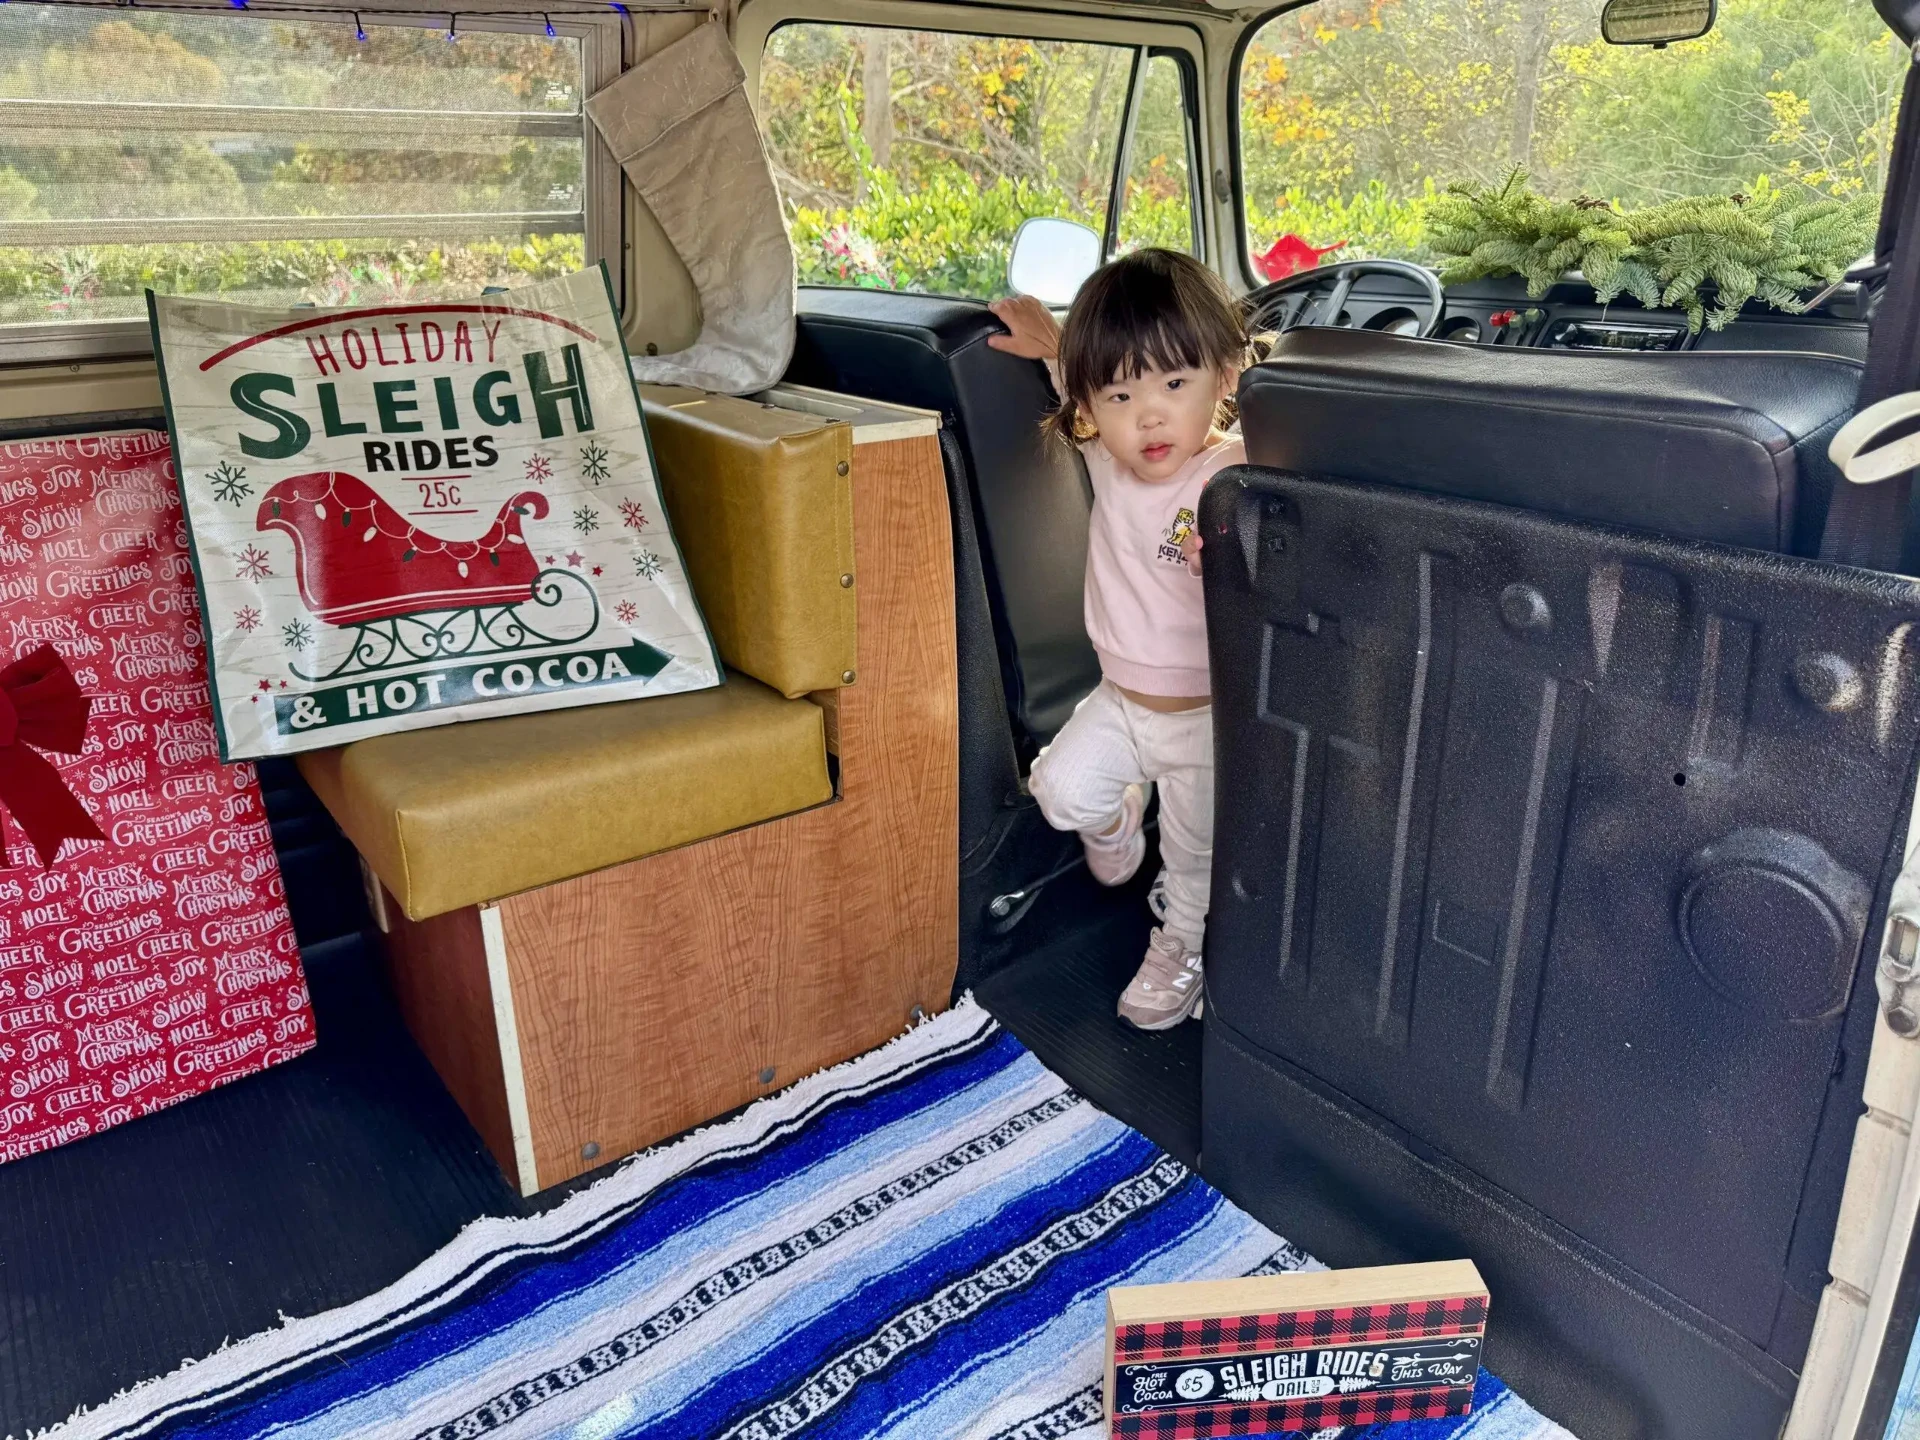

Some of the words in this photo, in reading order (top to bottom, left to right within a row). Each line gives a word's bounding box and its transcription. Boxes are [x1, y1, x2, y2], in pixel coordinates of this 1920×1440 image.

[306, 320, 502, 377] HOLIDAY
[230, 344, 595, 460] SLEIGH
[77, 432, 170, 460] GREETING
[363, 436, 499, 473] RIDES
[42, 465, 82, 494] JOY
[89, 466, 162, 497] MERRY
[95, 487, 180, 517] CHRISTMAS
[22, 507, 82, 539] SNOW
[42, 538, 90, 562] NOEL
[100, 530, 164, 552] CHEER
[1158, 544, 1188, 562] KEN
[46, 562, 152, 598] GREETINGS
[83, 565, 119, 575] SEASON'S
[0, 576, 38, 602] NOW
[9, 615, 84, 648] MERRY
[88, 605, 154, 629] CHEER
[109, 632, 181, 664] MERRY
[115, 652, 199, 682] CHRISTMAS
[89, 695, 138, 716] HEER
[141, 686, 209, 713] GREETI
[289, 696, 327, 730] &
[347, 675, 447, 718] HOT
[472, 652, 631, 698] COCOA
[108, 720, 146, 750] JOY
[89, 760, 147, 793] SNOW
[161, 775, 224, 800] CHEER
[108, 788, 154, 814] NOEL
[220, 793, 253, 822] JOY
[112, 806, 213, 846] GREETINGS
[146, 811, 181, 823] SEASON'S
[152, 848, 214, 873] CHEER
[241, 852, 279, 882] SNO
[28, 872, 68, 901] JOY
[78, 866, 148, 898] MERRY
[173, 873, 239, 904] MERRY
[83, 880, 167, 915] CHRISTMAS
[177, 886, 255, 921] CHRISTMAS
[21, 902, 70, 930] NOEL
[94, 916, 130, 930] SEASON'S
[201, 904, 290, 947] GREETINGS
[233, 911, 266, 923] SEASON'S
[59, 909, 162, 954] GREETINGS
[138, 933, 200, 960] CHEER
[0, 945, 53, 969] HEER
[93, 953, 140, 981] NOEL
[170, 956, 206, 986] JOY
[213, 948, 277, 982] MERRY
[25, 963, 84, 999] SNOW
[100, 981, 135, 994] SEASON'S
[218, 960, 293, 997] CHRISTMAS
[64, 973, 167, 1019] GREETINGS
[153, 992, 207, 1028] SNOW
[0, 1004, 63, 1033] CHEER
[220, 1000, 279, 1028] CHEER
[273, 1013, 307, 1042] JOY
[21, 1030, 61, 1061] JOY
[74, 1019, 145, 1054] MERRY
[169, 1019, 213, 1047] NOEL
[206, 1038, 239, 1051] SEASON'S
[80, 1031, 163, 1070] CHRISTMAS
[174, 1028, 267, 1076] GREETINGS
[10, 1059, 70, 1098] SNOW
[111, 1059, 167, 1098] SNOW
[45, 1084, 110, 1114] CHEER
[0, 1101, 35, 1134] JOY
[95, 1104, 132, 1132] JOY
[20, 1125, 57, 1141] SEASON'S
[1133, 1377, 1166, 1391] HOT
[1151, 1372, 1168, 1380] FREE
[1182, 1375, 1204, 1392] $5
[1220, 1352, 1307, 1391] SLEIGH
[1316, 1350, 1390, 1377] RIDES
[1391, 1364, 1424, 1381] THIS
[1428, 1362, 1464, 1376] WAY
[1134, 1389, 1173, 1403] COCOA
